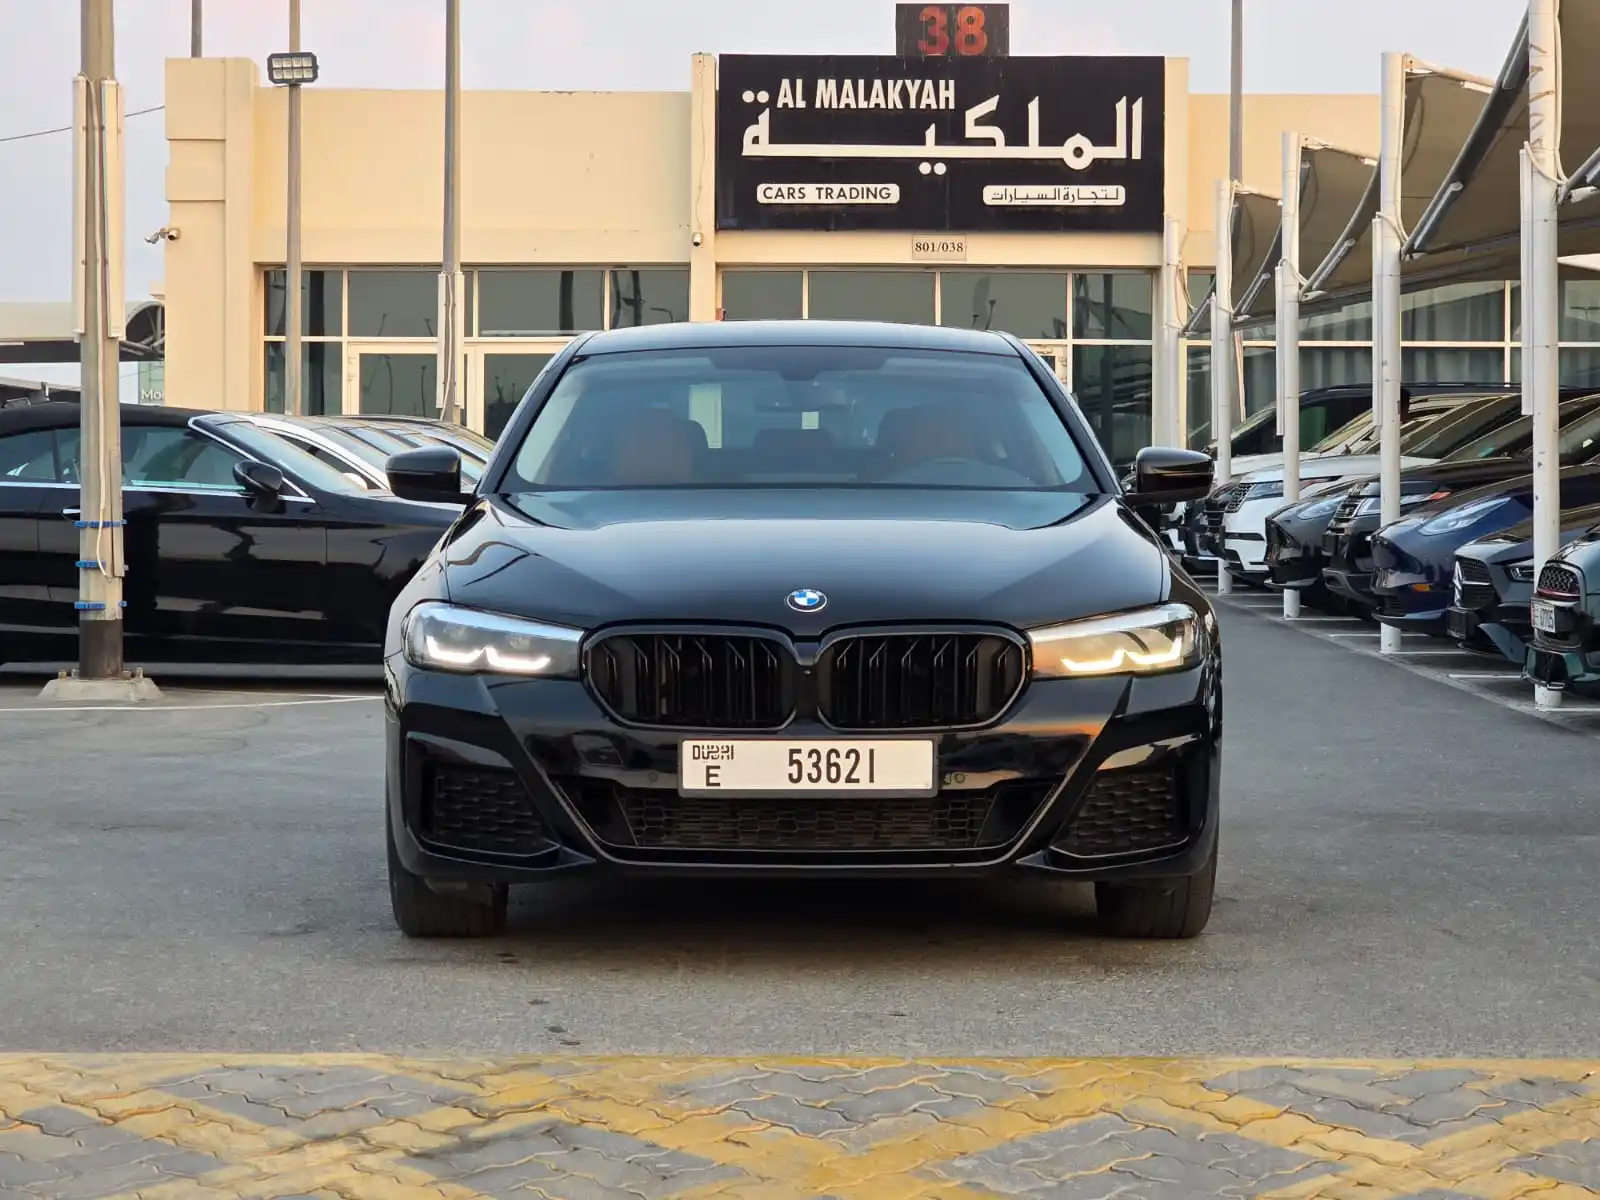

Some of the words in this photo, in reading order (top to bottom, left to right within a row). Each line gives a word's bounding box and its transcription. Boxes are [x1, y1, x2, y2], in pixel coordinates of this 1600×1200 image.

[917, 5, 988, 57] 38
[776, 78, 807, 109] AL
[814, 78, 956, 110] MALAKYAH
[741, 90, 1143, 176] الملكية
[762, 186, 807, 200] CARS
[815, 186, 892, 200] TRADING
[990, 187, 1061, 204] السيارات
[1062, 187, 1120, 204] لتجارة
[915, 241, 964, 253] 801/038
[141, 389, 165, 400] Mo
[692, 744, 734, 761] DUBAI
[788, 748, 875, 784] 53621
[705, 765, 721, 787] E
